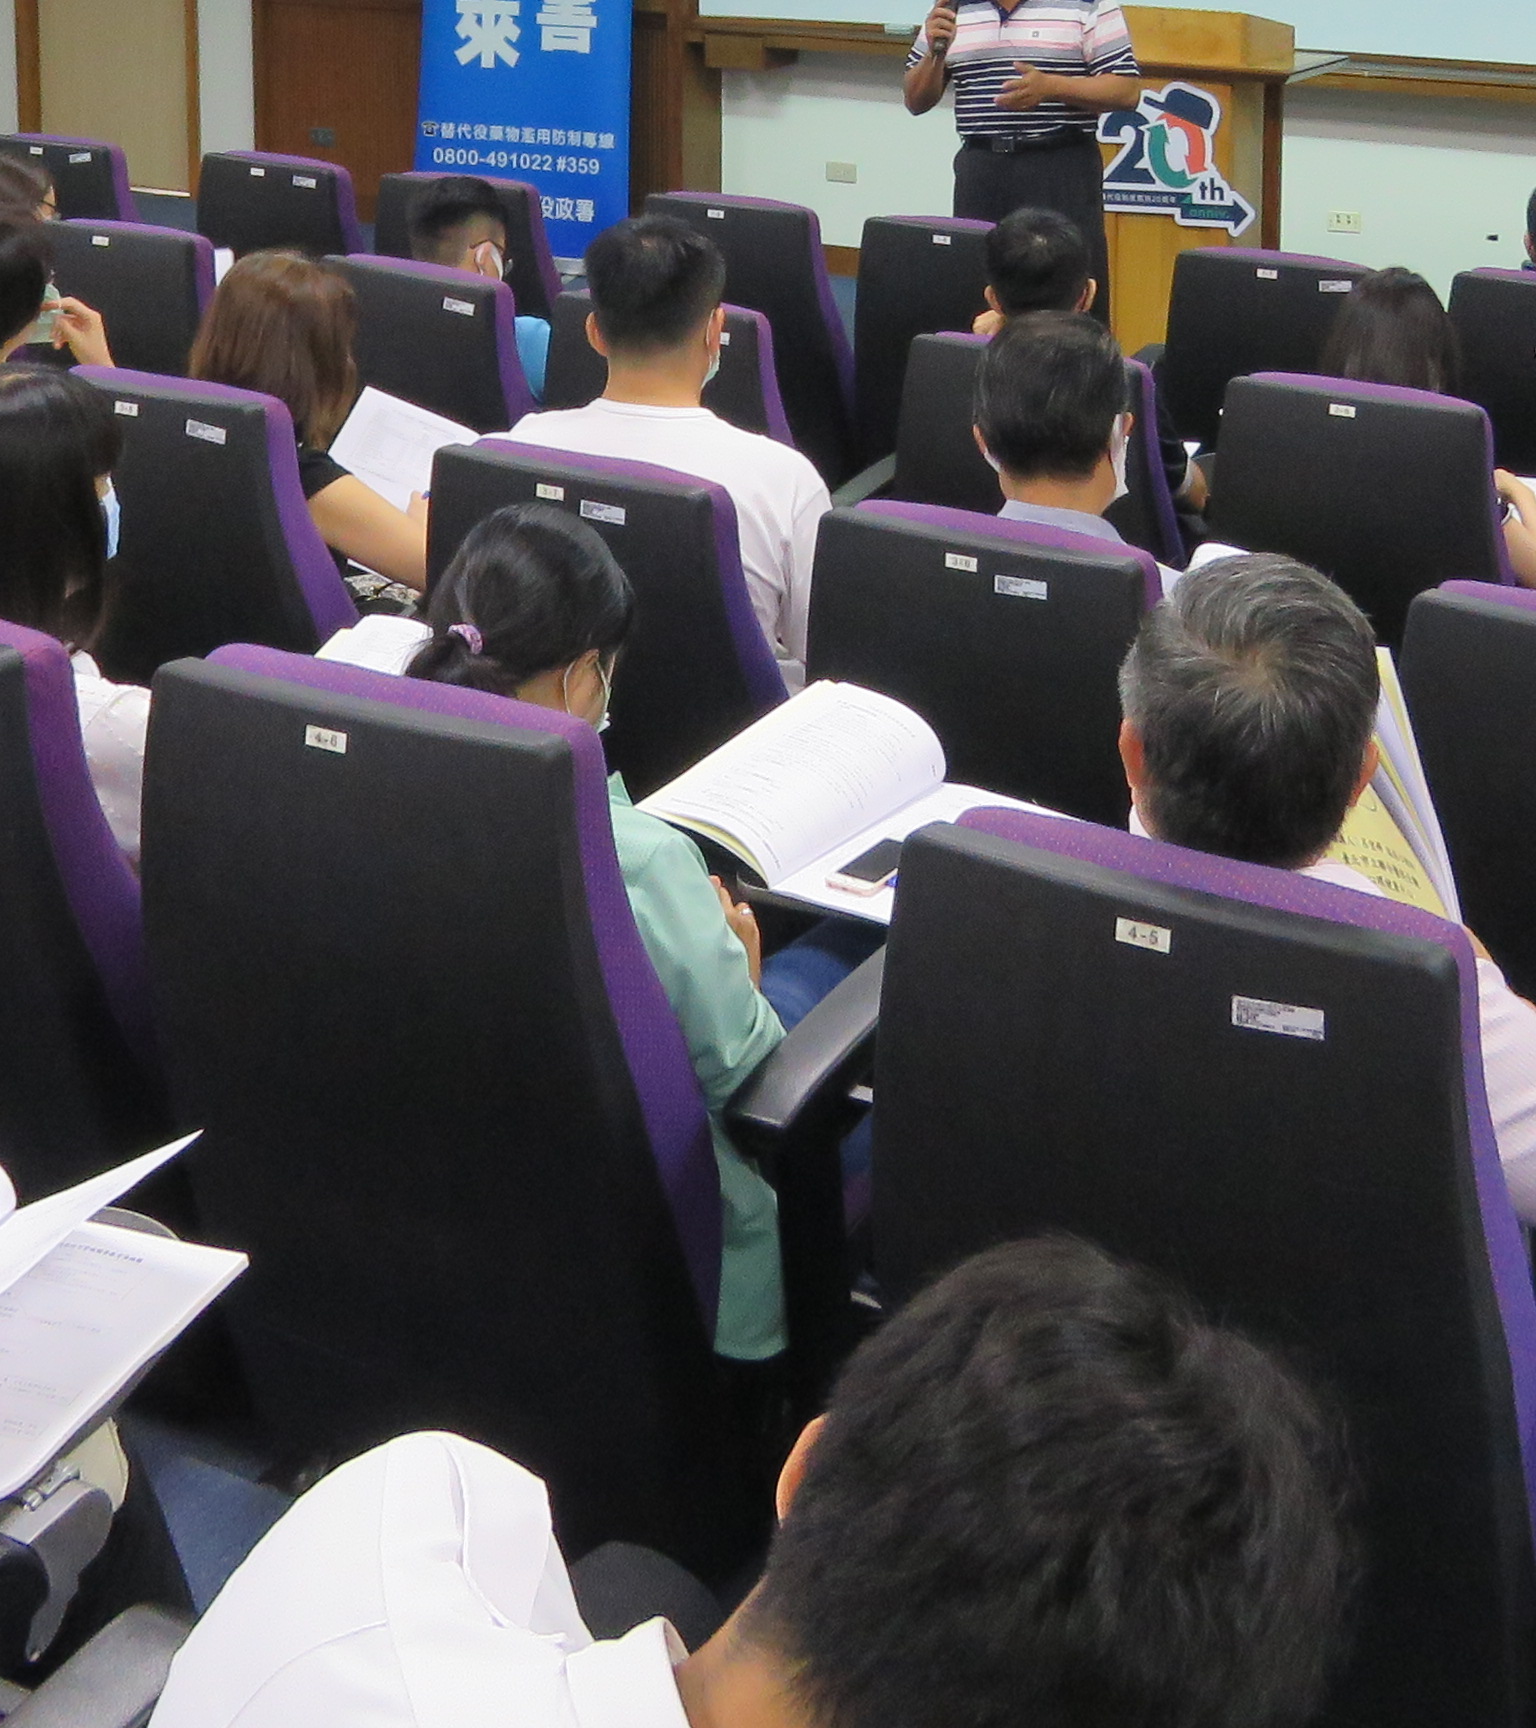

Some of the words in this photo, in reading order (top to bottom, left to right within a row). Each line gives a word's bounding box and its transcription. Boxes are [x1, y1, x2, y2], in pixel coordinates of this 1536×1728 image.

[433, 147, 553, 172] 0800-491022
[556, 155, 601, 175] #359
[1128, 925, 1159, 945] 4-5
